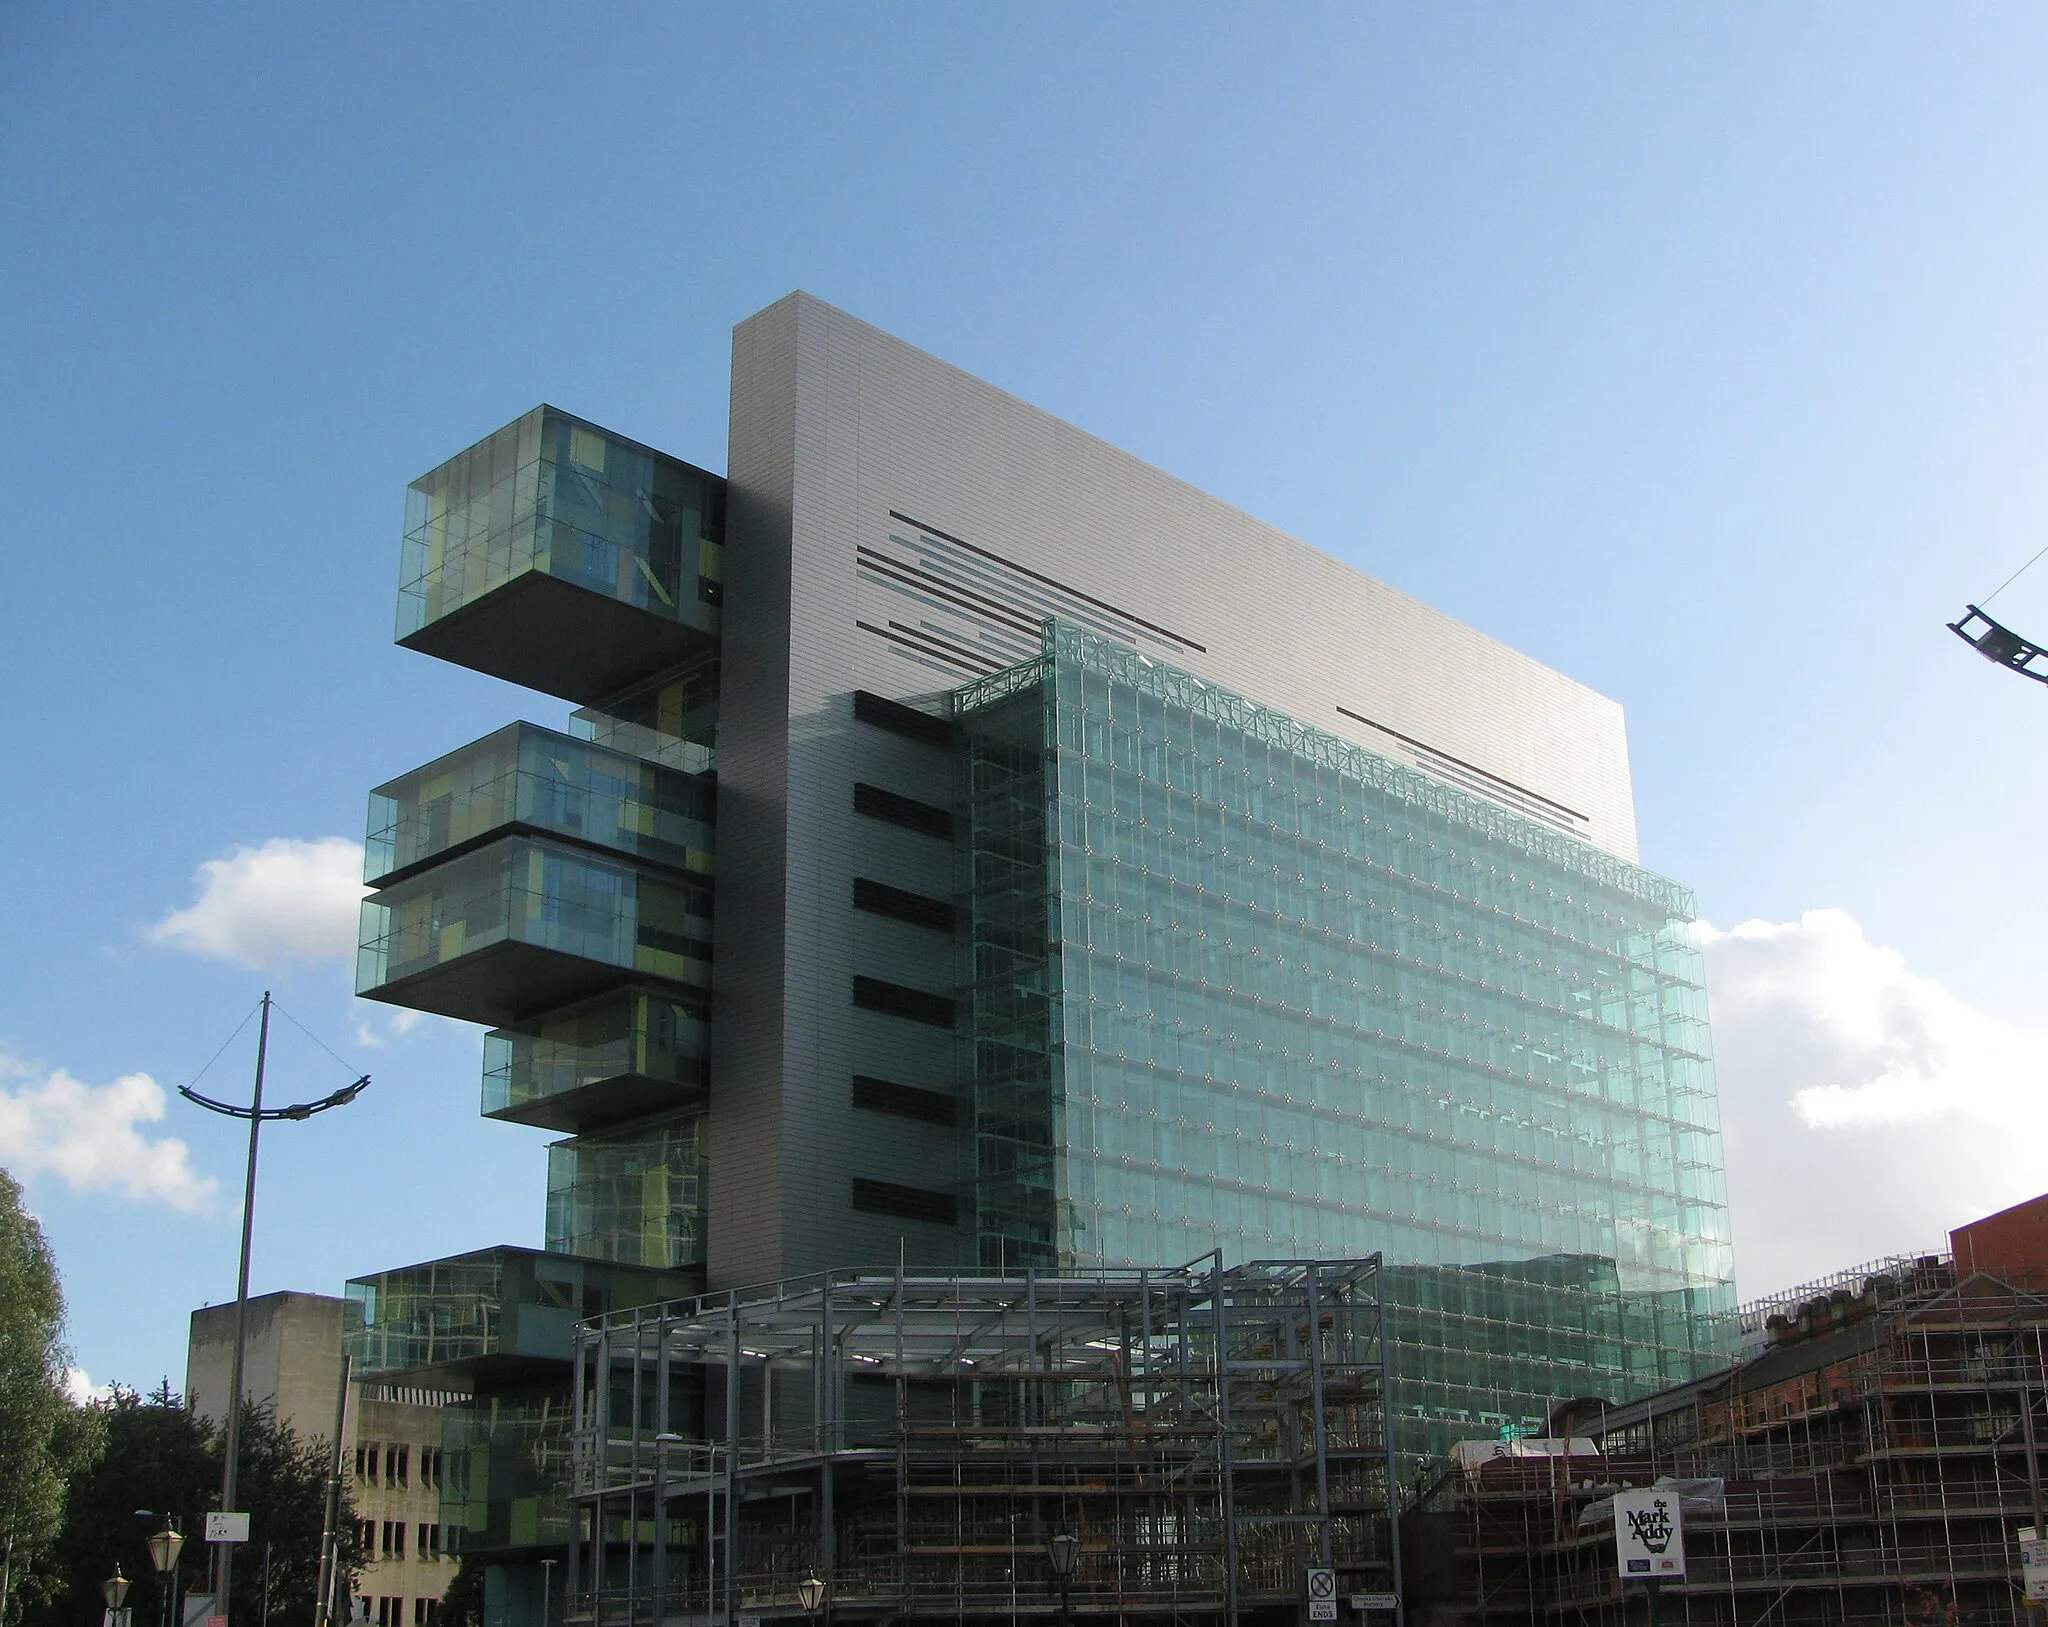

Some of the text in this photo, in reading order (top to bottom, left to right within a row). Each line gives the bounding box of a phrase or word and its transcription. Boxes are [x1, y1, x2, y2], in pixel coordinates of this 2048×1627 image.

[1653, 1499, 1667, 1508] the
[1626, 1507, 1670, 1526] Mark
[1631, 1523, 1674, 1549] Addy
[1313, 1610, 1333, 1618] ENDS
